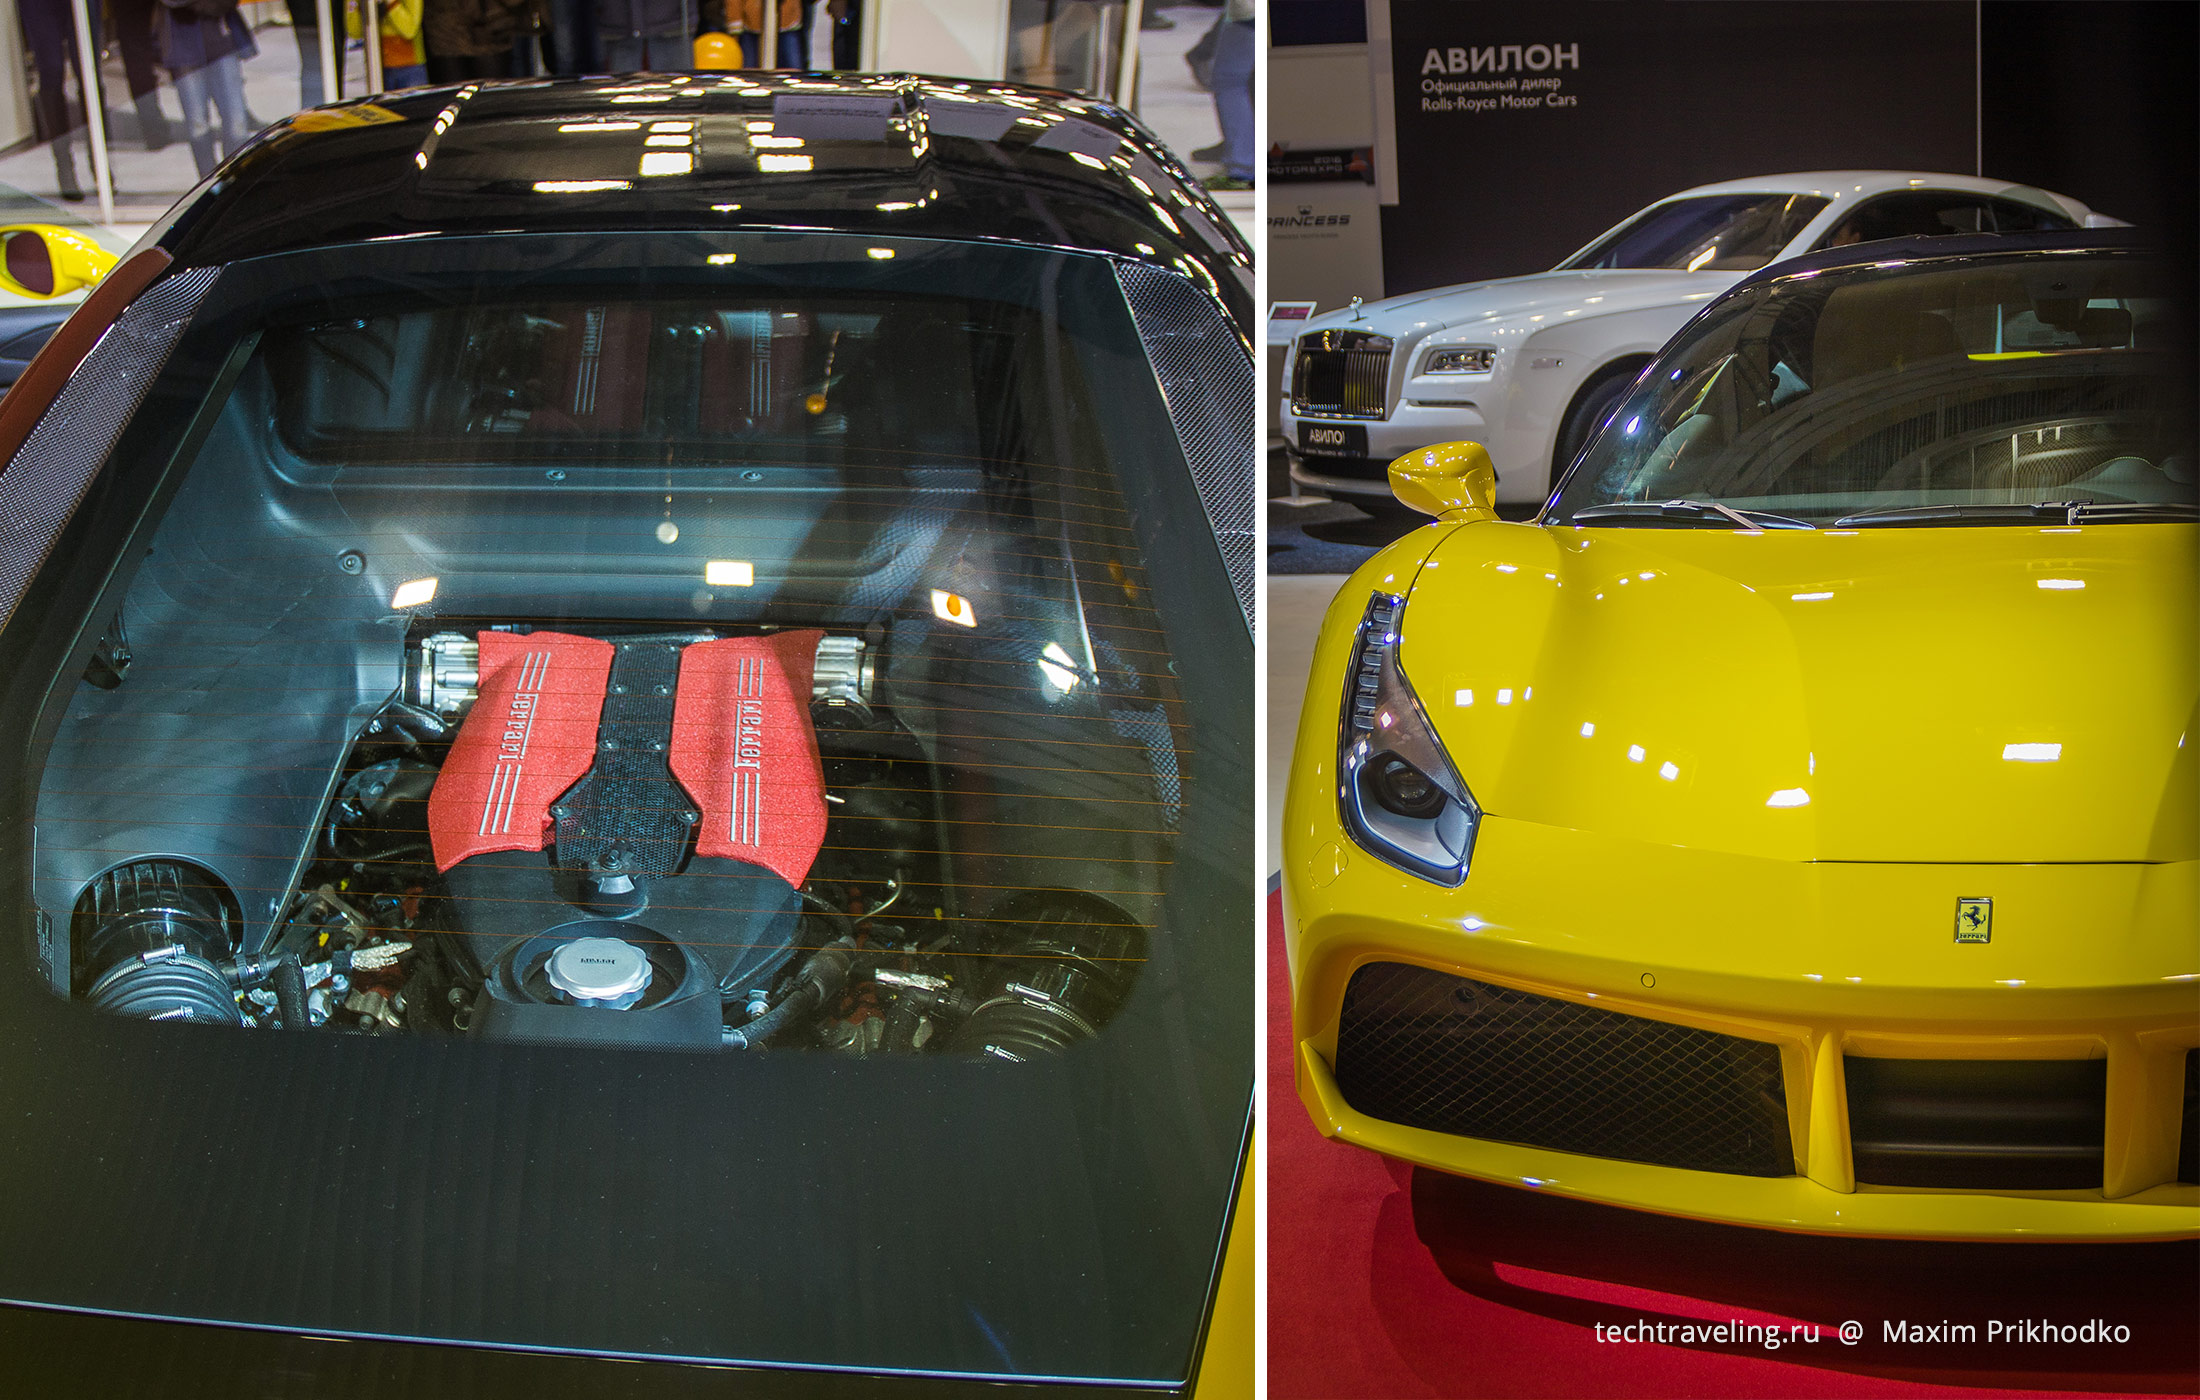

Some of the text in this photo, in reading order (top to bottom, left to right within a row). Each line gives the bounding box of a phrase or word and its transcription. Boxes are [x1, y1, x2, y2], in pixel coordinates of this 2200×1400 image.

[1421, 42, 1579, 75] АВИЛОН
[1421, 77, 1562, 95] Официальный дилер
[1421, 92, 1578, 113] Rolls-Royce Motor Cars
[498, 692, 539, 760] Ferrari
[733, 699, 762, 769] Ferrari
